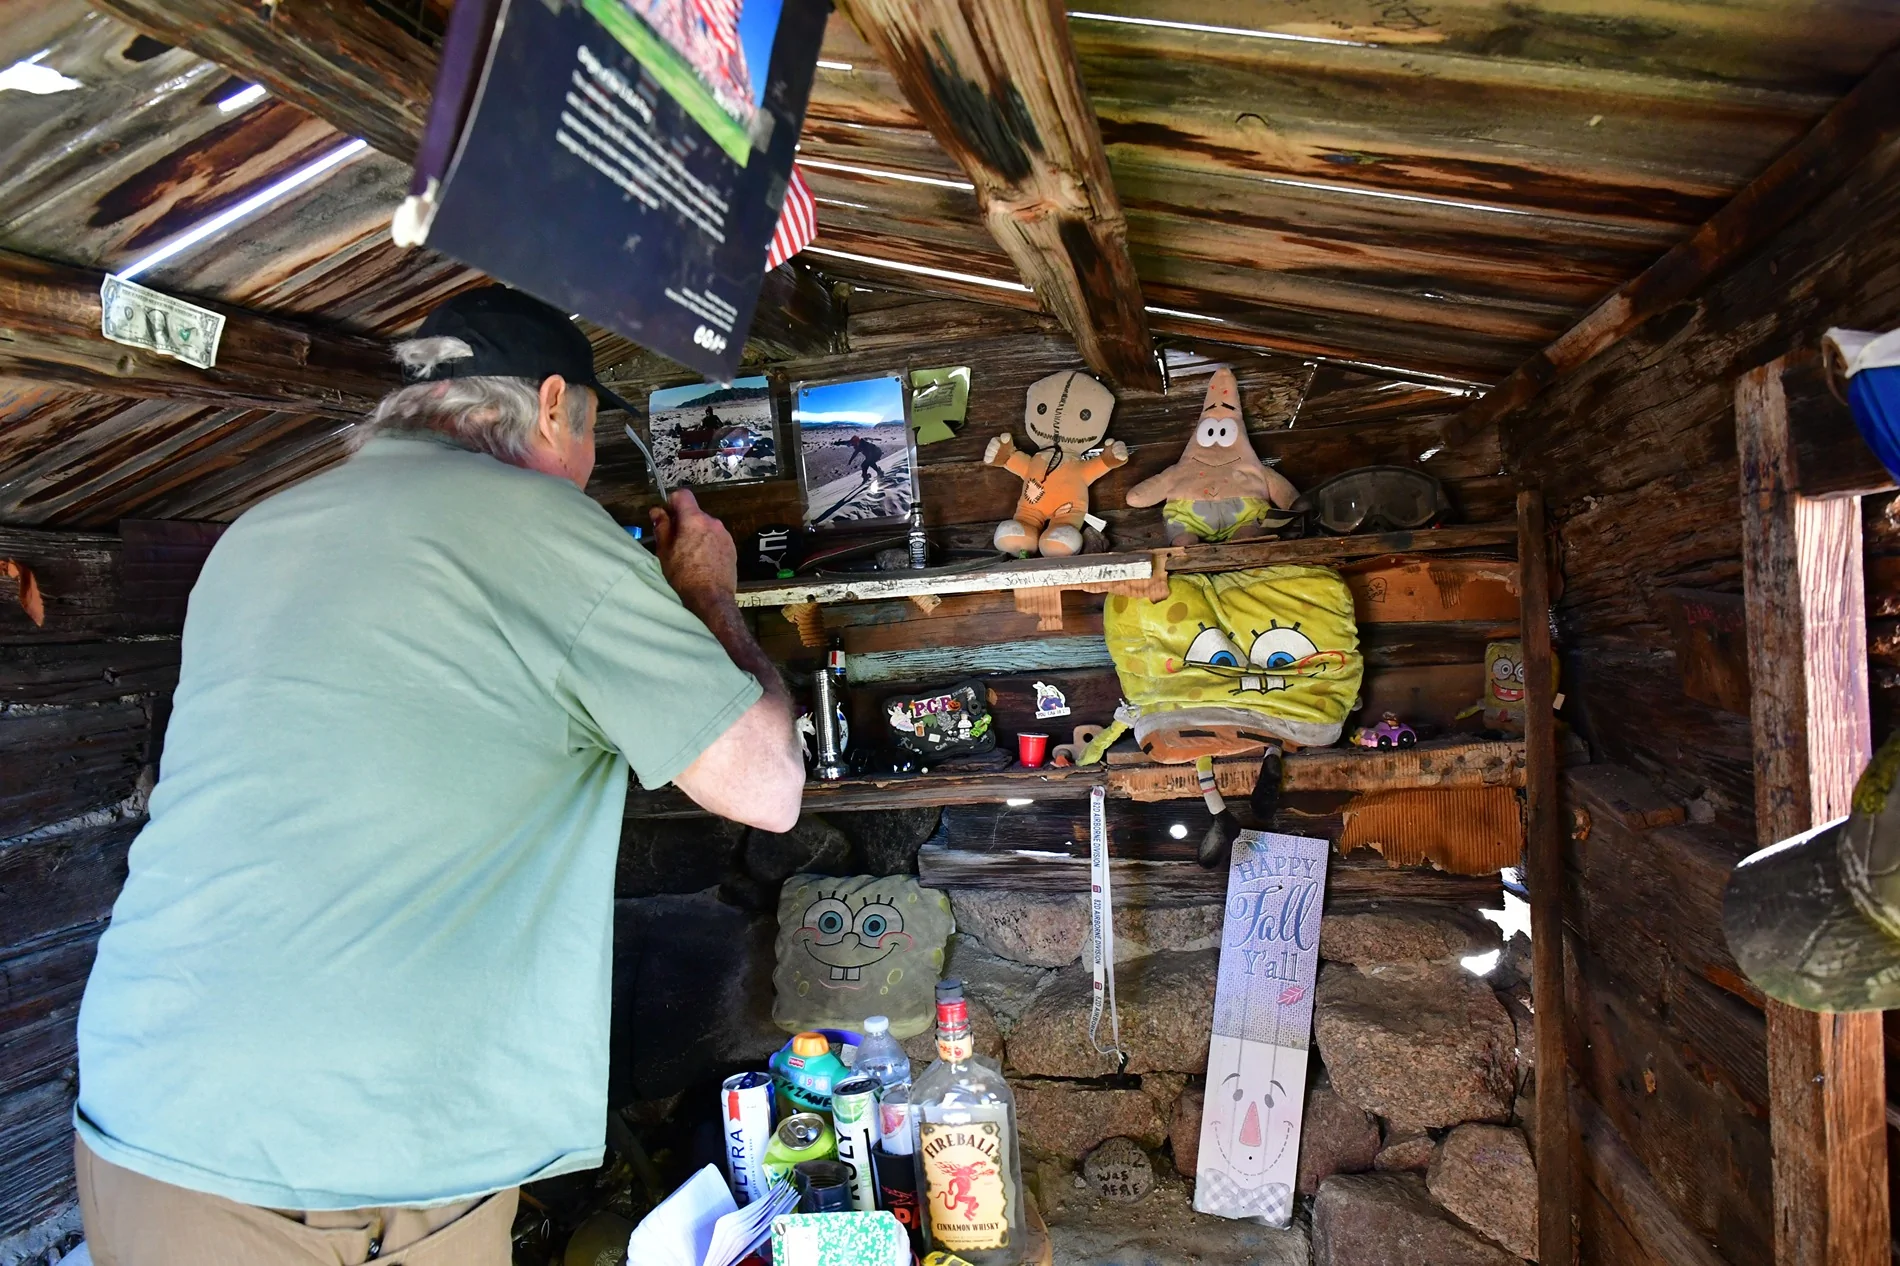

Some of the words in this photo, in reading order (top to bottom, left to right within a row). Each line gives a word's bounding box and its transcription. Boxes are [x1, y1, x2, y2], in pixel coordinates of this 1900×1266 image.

[1093, 813, 1102, 842] AIRBORNE
[1093, 842, 1101, 868] DIVISION
[1236, 856, 1318, 884] HAPPY
[1093, 910, 1102, 940] AIRBORNE
[1228, 882, 1319, 951] Fall
[1093, 940, 1102, 965] DIVISION
[1242, 949, 1298, 982] Y'all
[924, 1132, 998, 1160] FIREBALL
[730, 1128, 750, 1204] ULTRA
[860, 1163, 872, 1188] LIME
[936, 1222, 971, 1232] CINNAMON
[972, 1221, 1000, 1231] WHISKY
